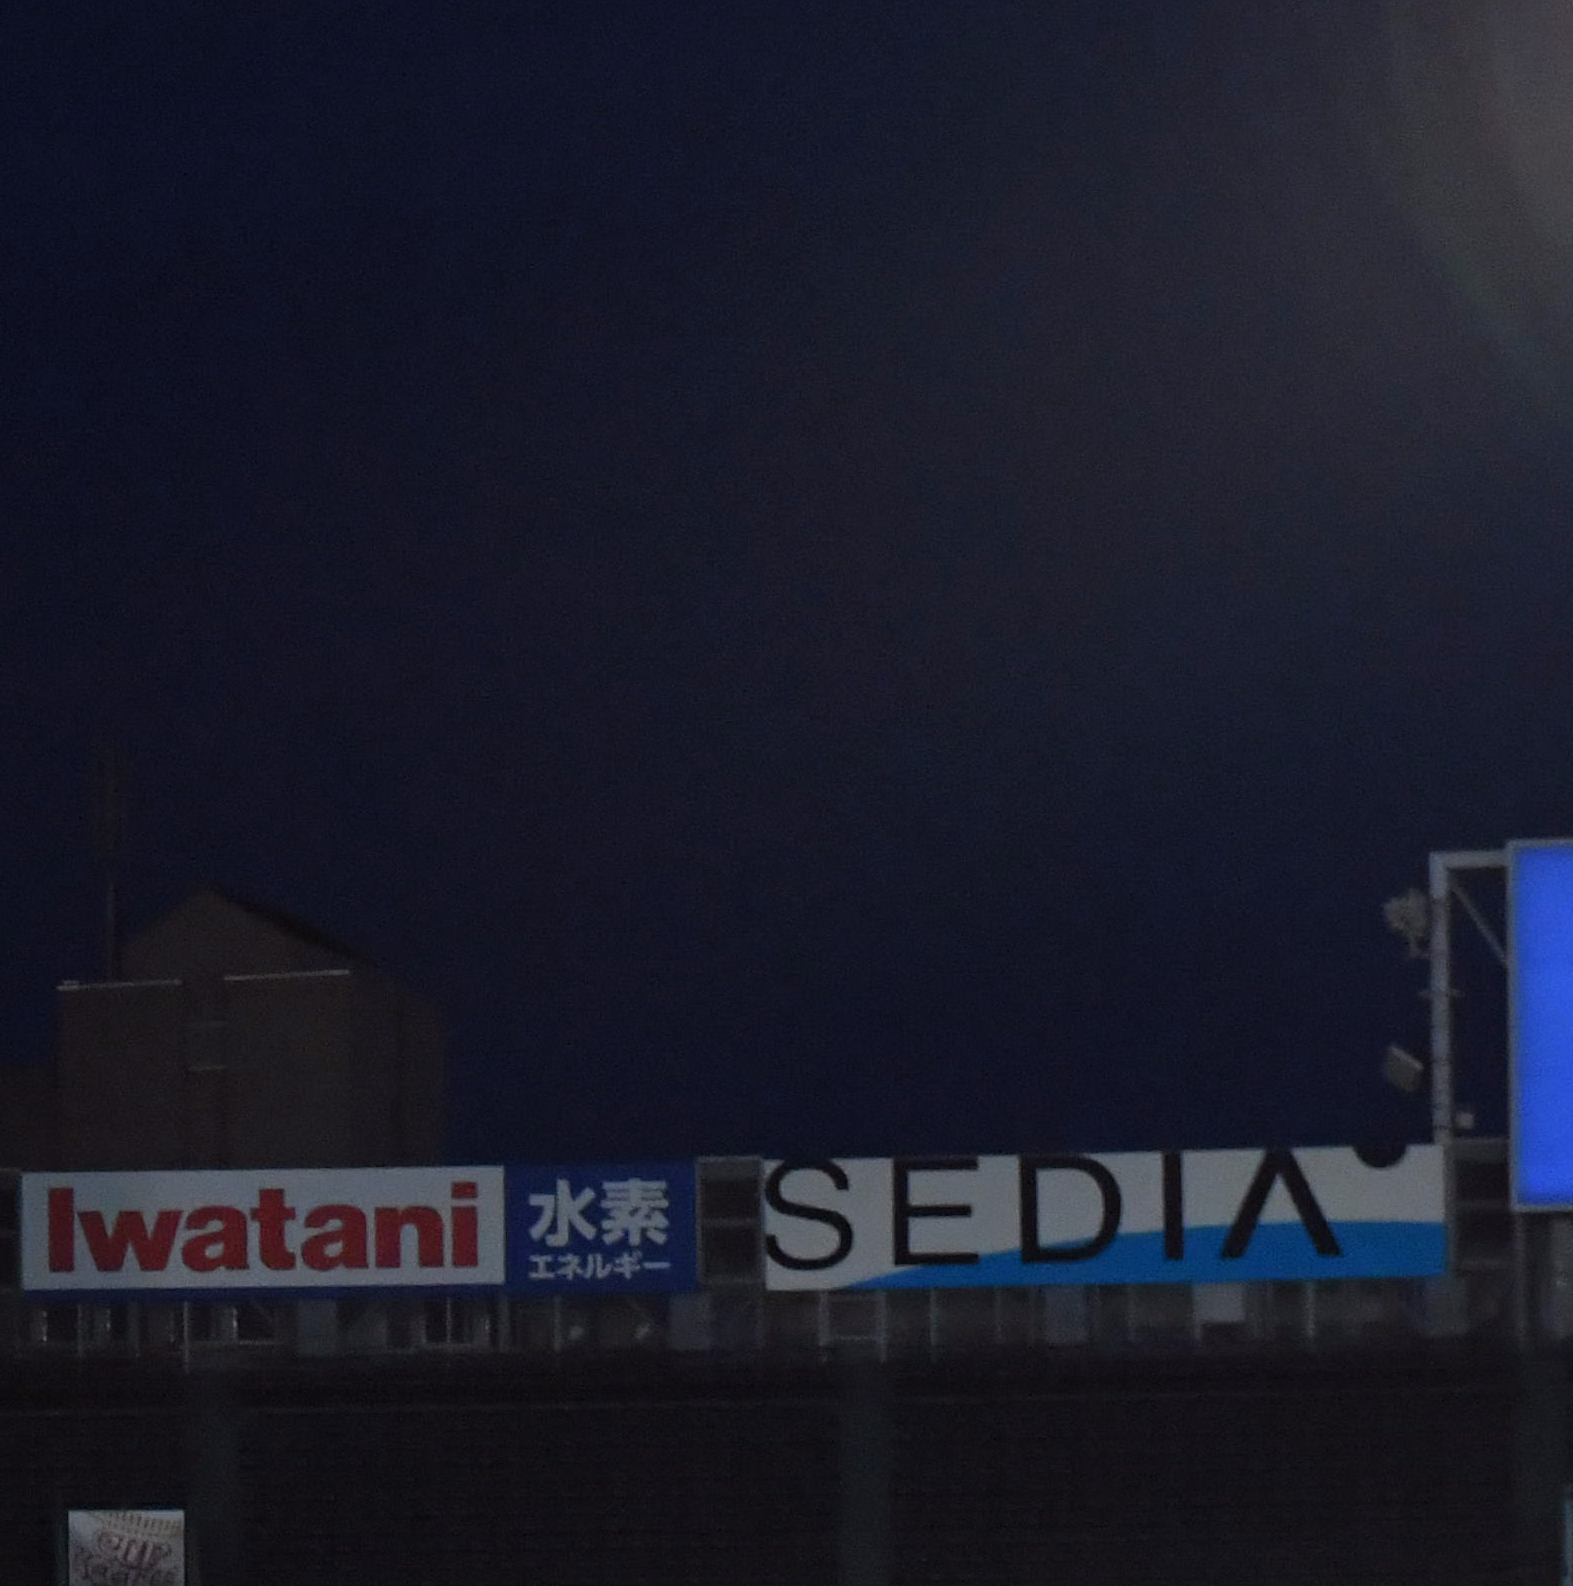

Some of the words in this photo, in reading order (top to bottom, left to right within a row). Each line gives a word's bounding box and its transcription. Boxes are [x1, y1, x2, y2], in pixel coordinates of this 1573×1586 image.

[46, 1180, 481, 1274] Iwatani
[528, 1178, 670, 1247] 水素
[764, 1149, 1343, 1271] SEDIA
[528, 1250, 671, 1280] エネルギー
